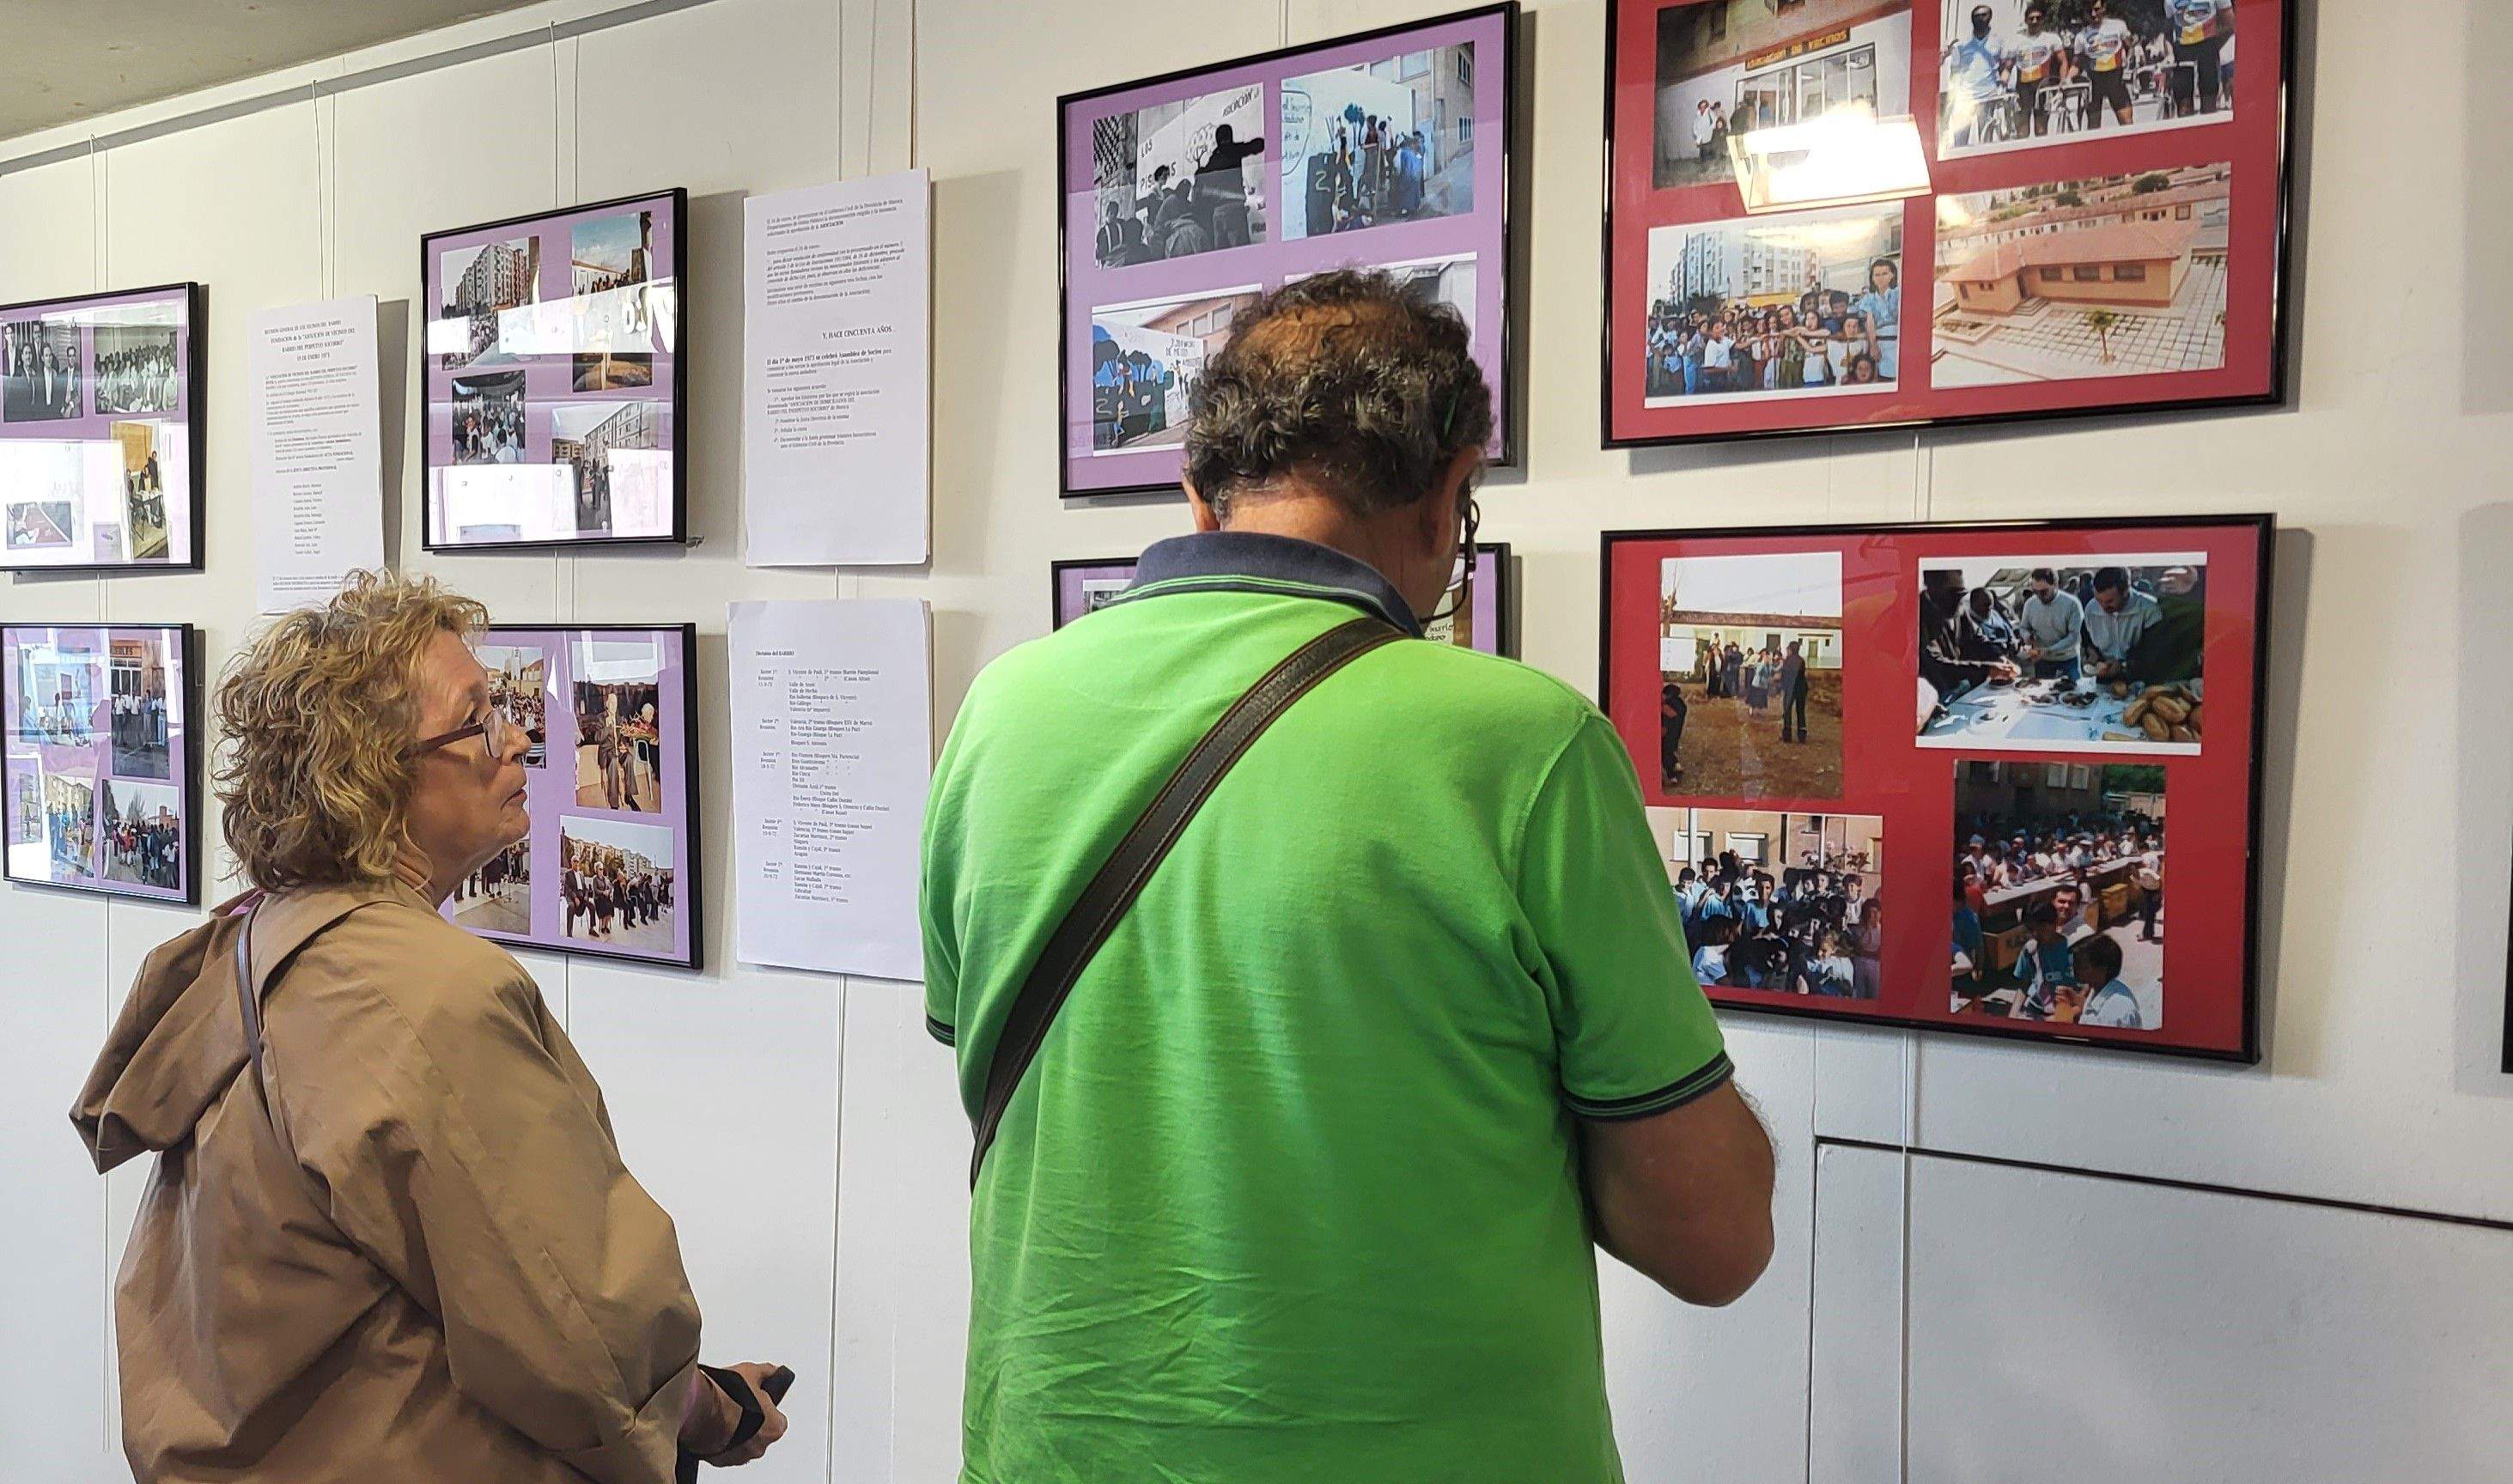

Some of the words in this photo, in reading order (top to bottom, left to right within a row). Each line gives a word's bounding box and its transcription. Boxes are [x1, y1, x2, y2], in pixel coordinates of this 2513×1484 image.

[828, 331, 843, 339] HACE
[844, 327, 875, 337] CINCUENTA
[877, 325, 892, 333] AÑOS
